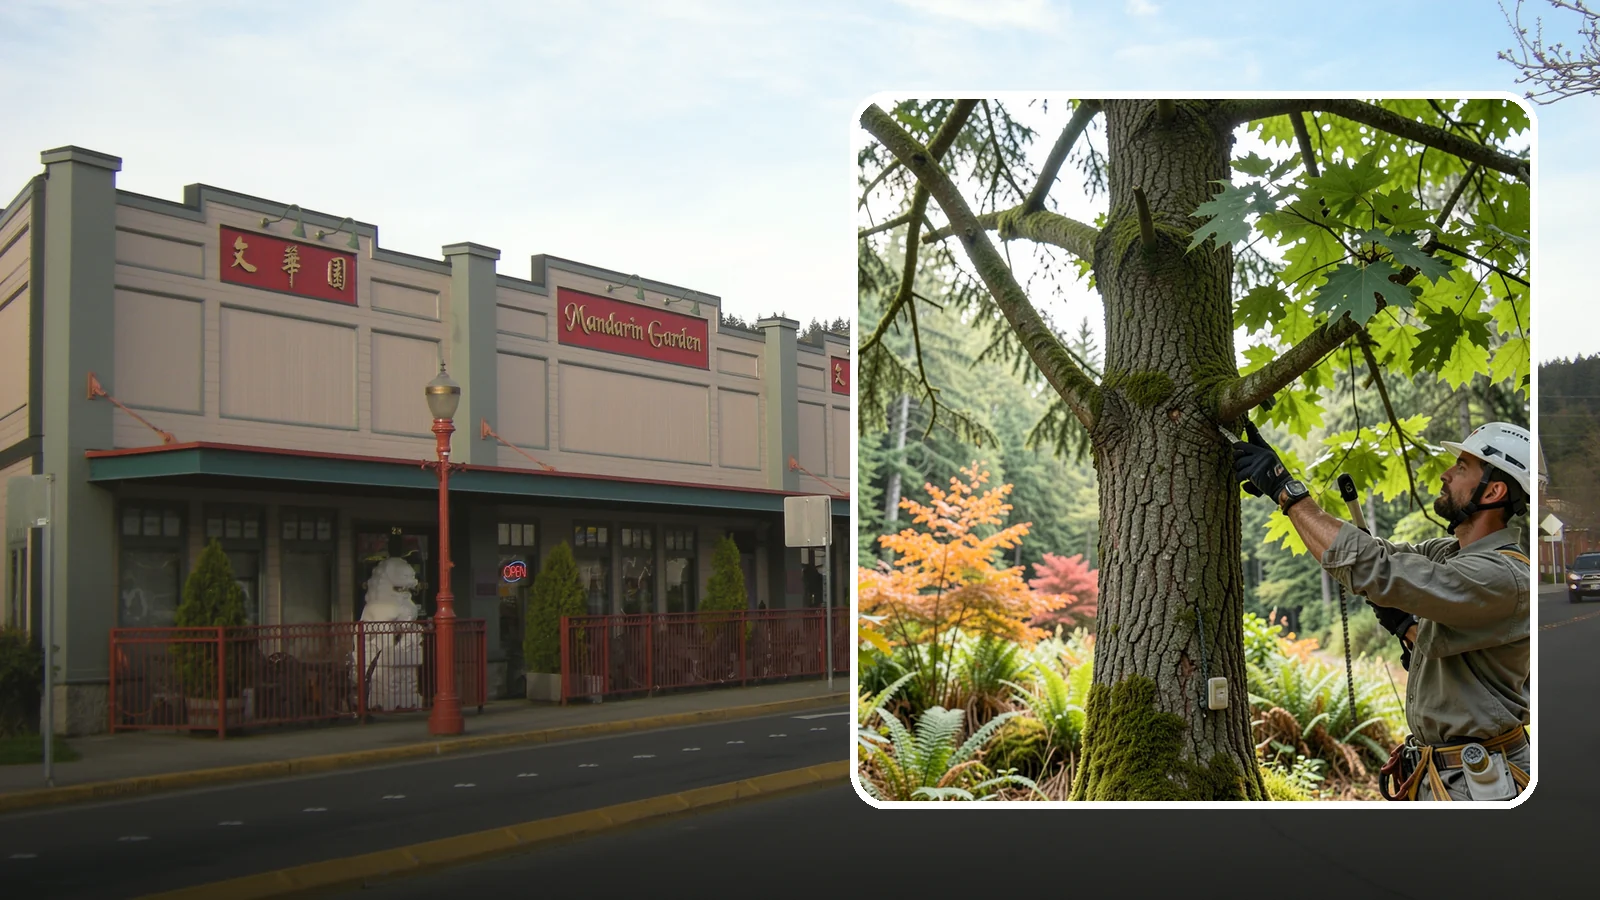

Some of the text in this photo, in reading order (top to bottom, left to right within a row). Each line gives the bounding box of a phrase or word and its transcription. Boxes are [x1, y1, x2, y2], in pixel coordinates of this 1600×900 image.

[230, 235, 346, 291] 文華園
[564, 302, 702, 352] Mandarin Garden
[503, 565, 527, 579] OPEN
